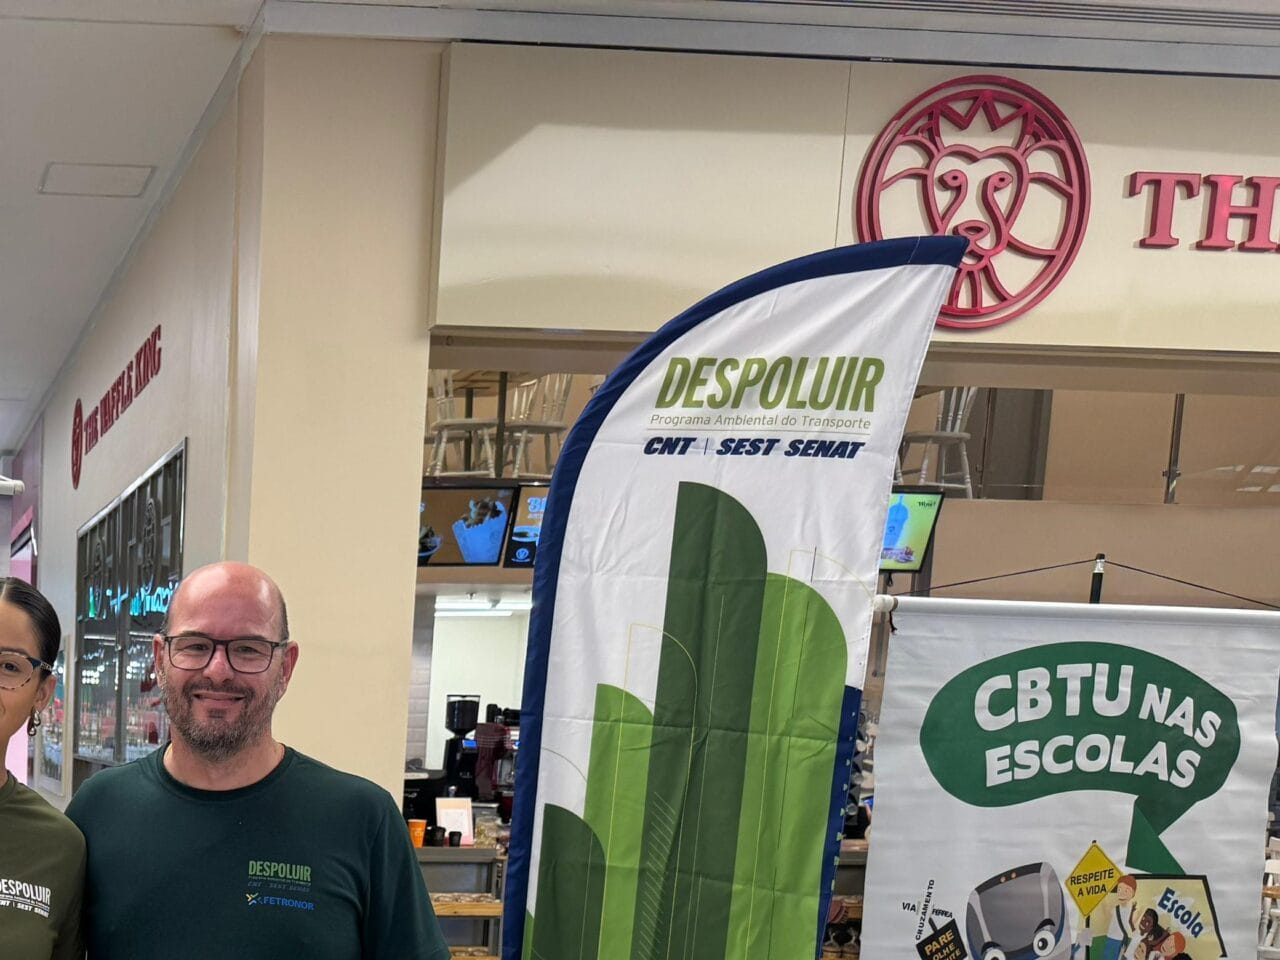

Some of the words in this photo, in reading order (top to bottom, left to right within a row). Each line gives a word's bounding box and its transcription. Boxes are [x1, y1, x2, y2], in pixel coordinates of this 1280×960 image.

[1128, 171, 1280, 253] TH
[84, 405, 99, 455] THE
[134, 324, 162, 398] KING
[654, 355, 886, 412] DESPOLUIR
[650, 414, 711, 427] Programa
[714, 414, 777, 427] Ambiental
[781, 414, 797, 427] do
[801, 415, 871, 430] Transporte
[643, 436, 697, 455] CNT
[716, 437, 781, 456] SEST
[784, 439, 866, 459] SENAT
[974, 662, 1134, 731] CBTU
[1138, 683, 1221, 748] NAS
[985, 733, 1201, 788] ESCOLAS
[248, 860, 312, 881] DESPOLUIR
[1070, 868, 1114, 886] RESPEITE
[1077, 888, 1085, 897] A
[1087, 884, 1107, 896] VIDA
[263, 896, 316, 911] FETRONOR
[902, 901, 917, 912] VIA
[1157, 887, 1203, 939] Escola
[924, 929, 955, 956] PARE
